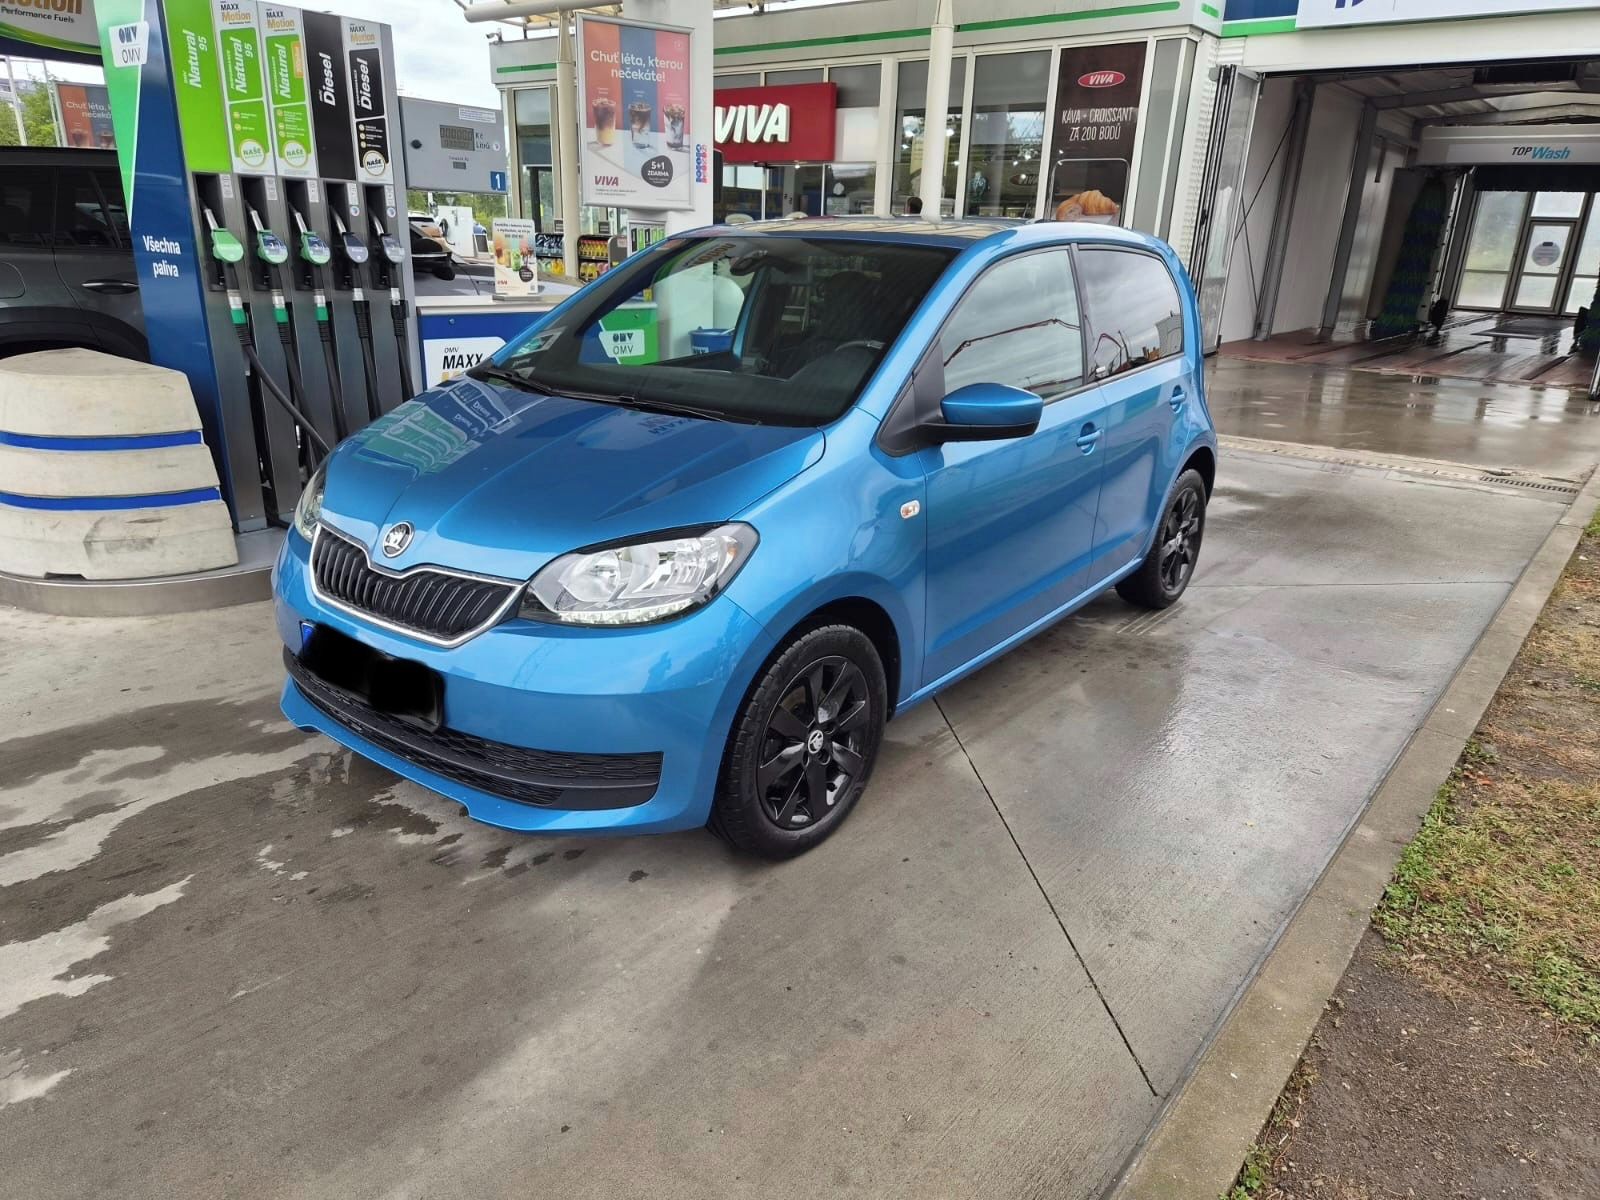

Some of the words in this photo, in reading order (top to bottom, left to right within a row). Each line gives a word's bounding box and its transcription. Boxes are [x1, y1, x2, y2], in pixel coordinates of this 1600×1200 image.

[0, 0, 82, 14] ion
[1, 6, 52, 19] Performance
[53, 14, 74, 23] Fuels
[222, 11, 251, 22] Motion
[266, 19, 295, 29] Motion
[119, 26, 138, 43] OMV
[198, 35, 208, 52] 95
[244, 42, 253, 57] 95
[121, 48, 141, 63] OMV
[182, 29, 202, 88] Natural
[590, 50, 619, 63] Chuť
[621, 52, 646, 68] léta,
[648, 55, 684, 70] kterou
[229, 37, 247, 93] Natural
[274, 43, 291, 98] Natural
[319, 52, 336, 106] Diesel
[611, 67, 666, 82] nečekáte!
[1088, 74, 1115, 85] VIVA
[356, 57, 373, 110] Diesel
[715, 103, 790, 143] VIVA
[1061, 108, 1081, 124] KÁVA
[1089, 106, 1133, 123] CROISSANT
[1069, 126, 1081, 141] ZA
[1081, 126, 1097, 141] 200
[1099, 123, 1121, 140] BODŮ
[651, 161, 665, 170] 5+1
[495, 173, 501, 189] 1
[594, 175, 619, 186] VIVA
[142, 235, 181, 255] Všechna
[153, 260, 179, 278] paliva
[613, 345, 634, 355] OMV
[443, 353, 484, 370] MAXX
